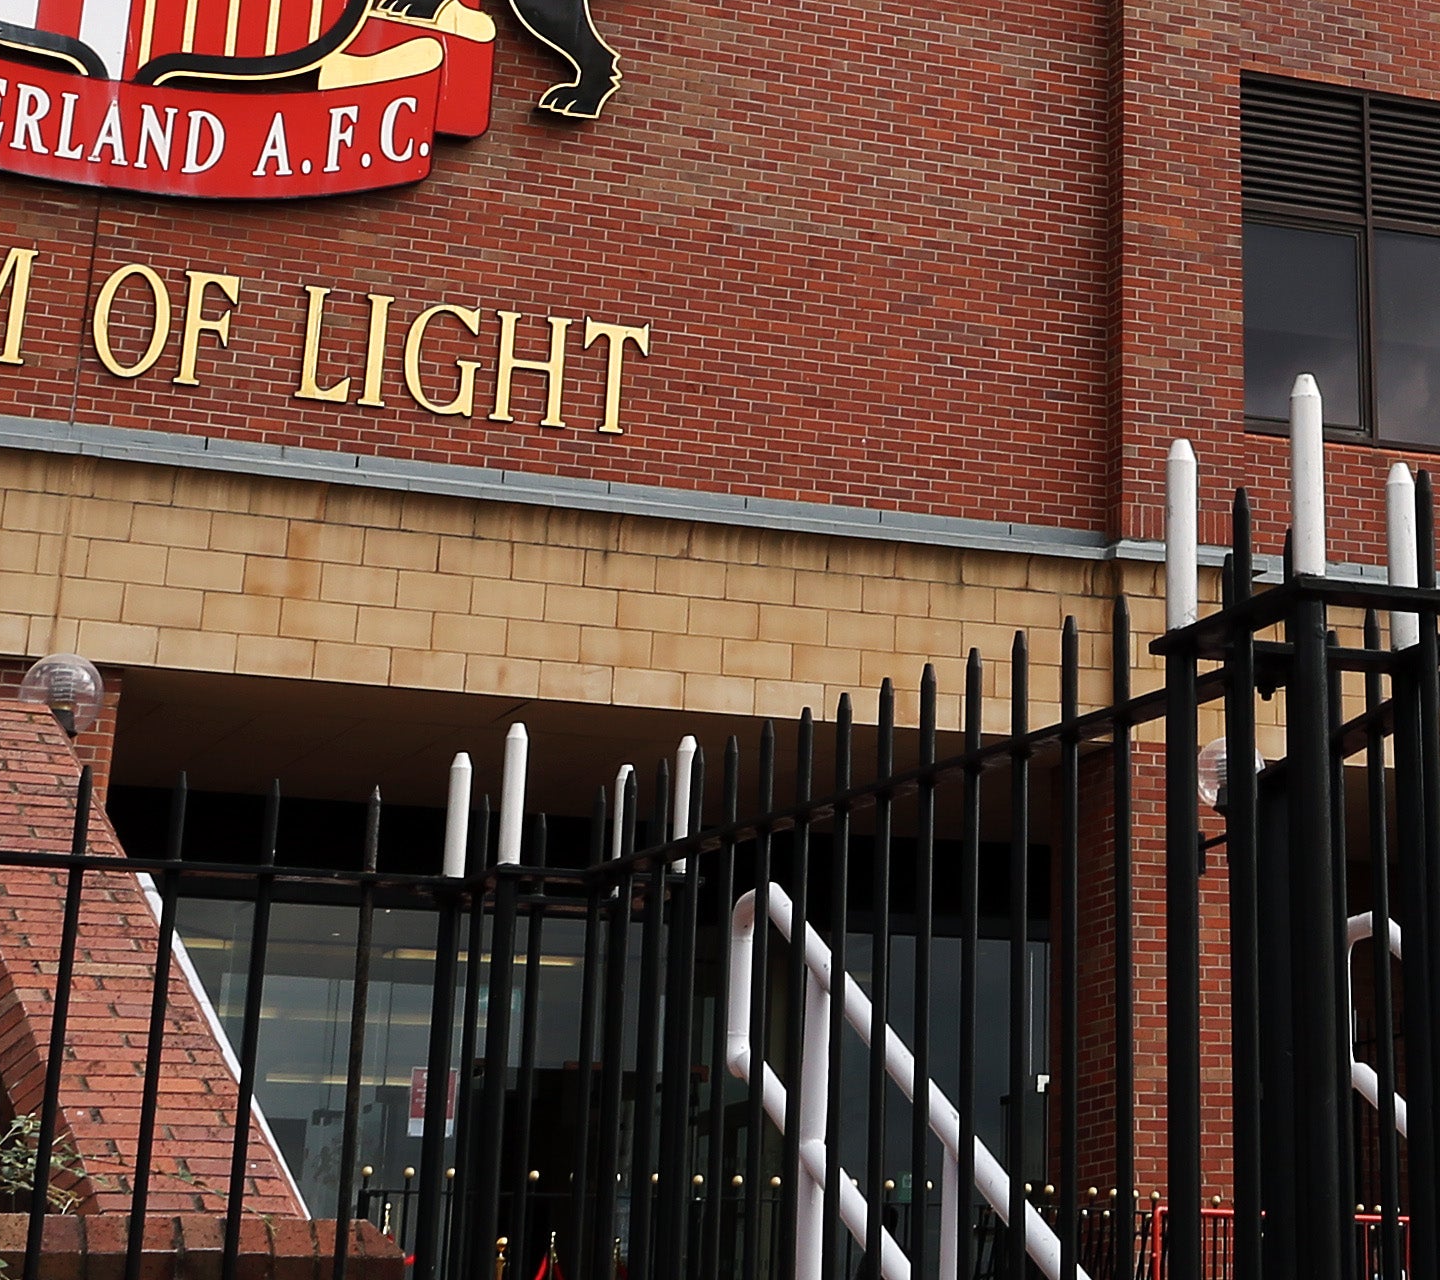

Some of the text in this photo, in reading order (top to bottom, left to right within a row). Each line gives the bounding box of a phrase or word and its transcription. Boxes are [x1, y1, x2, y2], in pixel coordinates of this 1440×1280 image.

[253, 97, 430, 177] A.F.C.
[93, 263, 241, 386] OF
[294, 285, 651, 435] LIGHT
